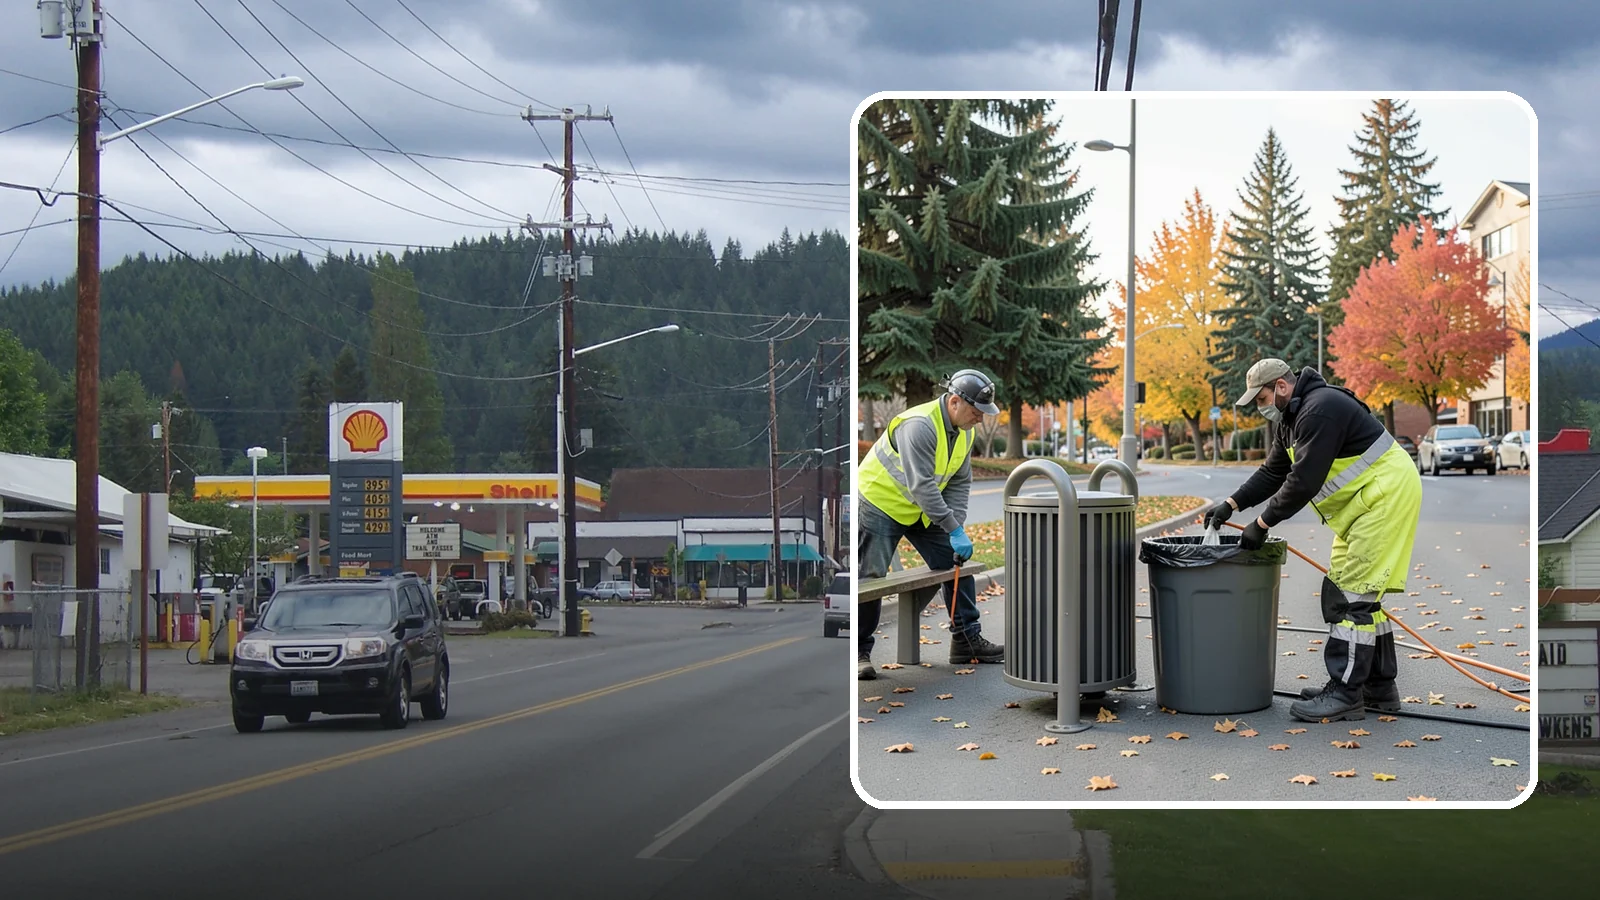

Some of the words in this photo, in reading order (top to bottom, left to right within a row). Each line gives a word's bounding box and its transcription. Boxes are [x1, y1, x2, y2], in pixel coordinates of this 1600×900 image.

[366, 480, 383, 490] 395
[490, 484, 547, 499] Shell
[366, 494, 383, 504] 405
[366, 508, 383, 517] 415
[366, 522, 383, 532] 429
[1539, 642, 1567, 666] AID
